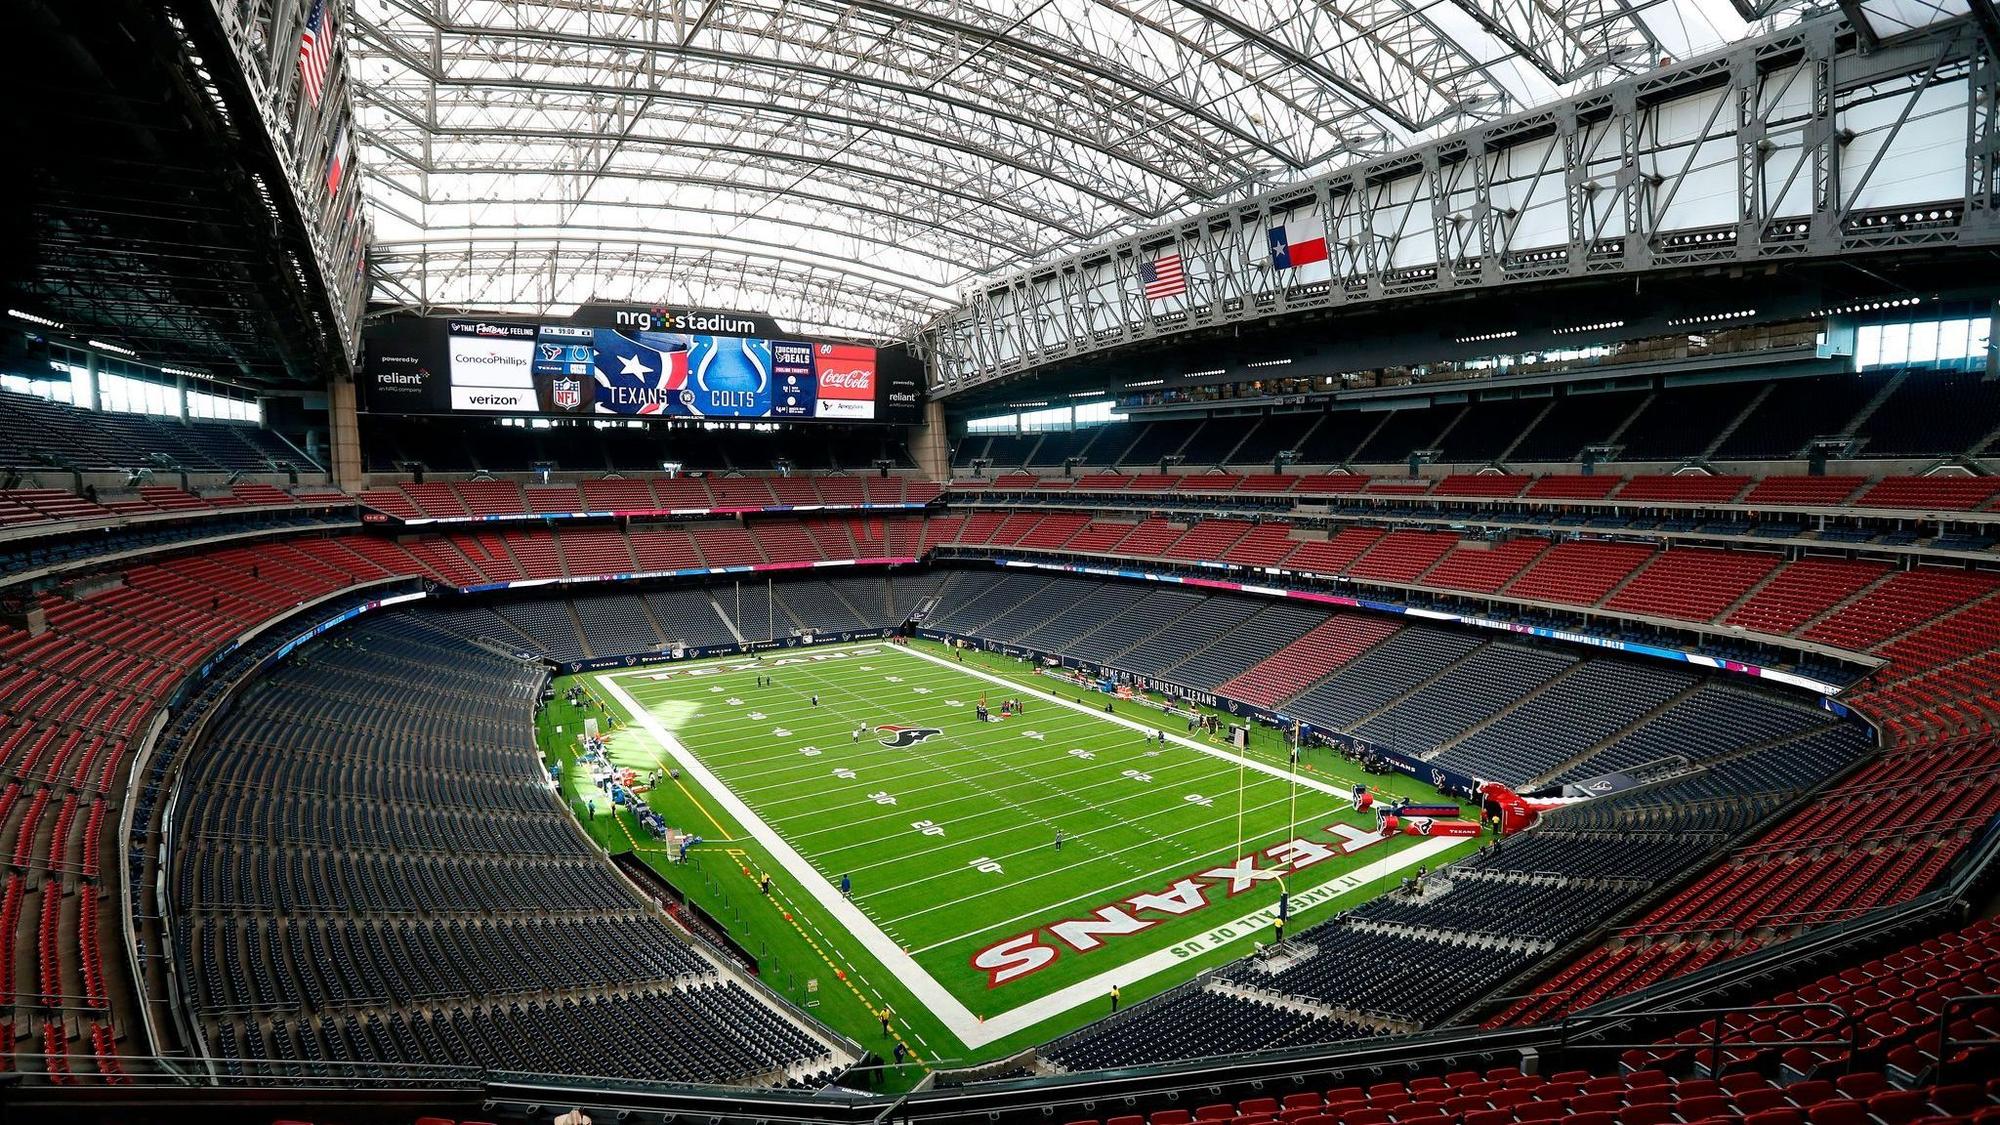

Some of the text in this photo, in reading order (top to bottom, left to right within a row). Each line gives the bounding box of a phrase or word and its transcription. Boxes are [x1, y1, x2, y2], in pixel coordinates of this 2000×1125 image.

[616, 311, 755, 333] nrg stadium
[460, 324, 475, 333] THAT
[510, 328, 534, 336] FEELING
[775, 346, 810, 355] TOUCHDOWN
[455, 354, 527, 367] ConocoPhillips
[785, 354, 810, 364] DEALS
[377, 372, 422, 385] reliant
[469, 394, 518, 405] verizon
[557, 391, 577, 406] NFL
[610, 387, 668, 404] TEXANS
[711, 390, 754, 407] COLTS
[889, 392, 915, 401] reliant
[1149, 679, 1184, 698] HOUSTON
[1187, 688, 1217, 707] TEXANS
[1384, 756, 1416, 773] TEXANS
[1121, 769, 1152, 783] 20
[867, 791, 896, 806] 30
[910, 819, 944, 836] 20
[968, 857, 1002, 873] 10
[970, 822, 1404, 988] TEXANS
[1169, 876, 1364, 958] IT TAKES ALL OF US
